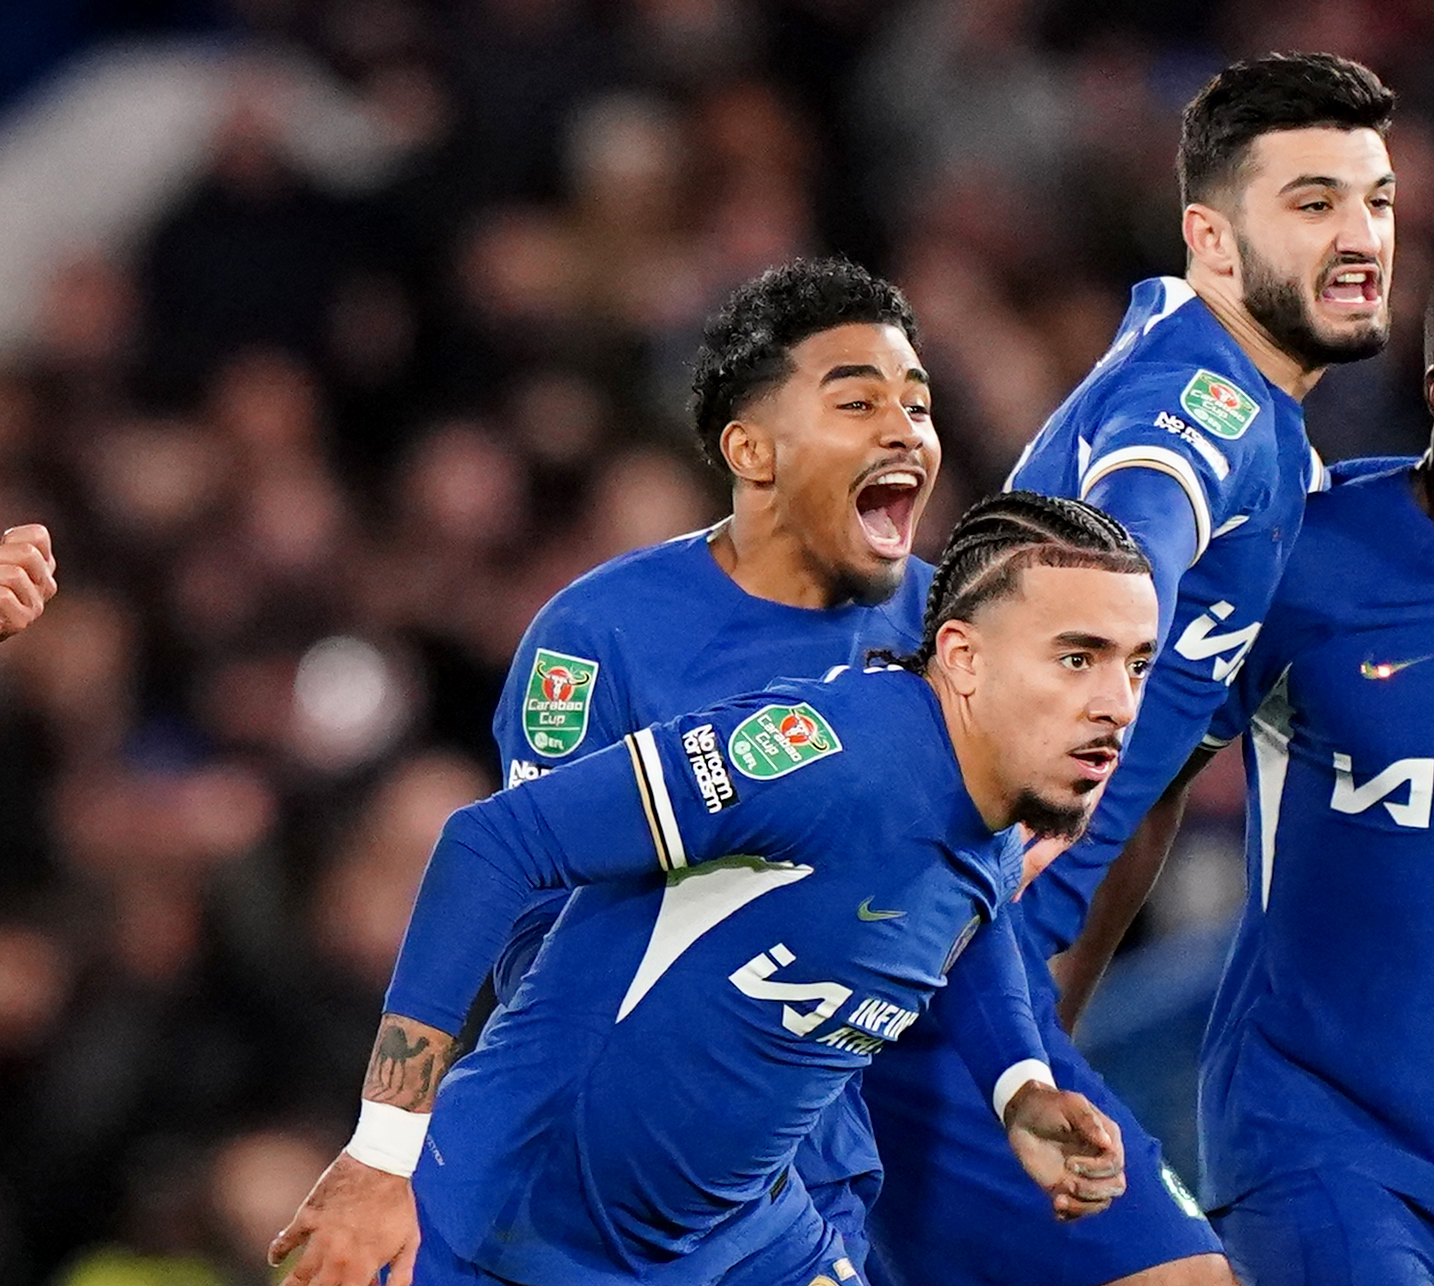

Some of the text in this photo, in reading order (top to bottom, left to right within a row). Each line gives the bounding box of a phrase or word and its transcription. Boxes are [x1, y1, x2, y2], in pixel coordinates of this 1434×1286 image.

[528, 698, 585, 712] Carabao
[539, 712, 566, 727] Cup
[755, 731, 780, 756] Cup
[757, 714, 803, 763] Carabao
[694, 723, 734, 801] No room
[689, 755, 723, 814] racism
